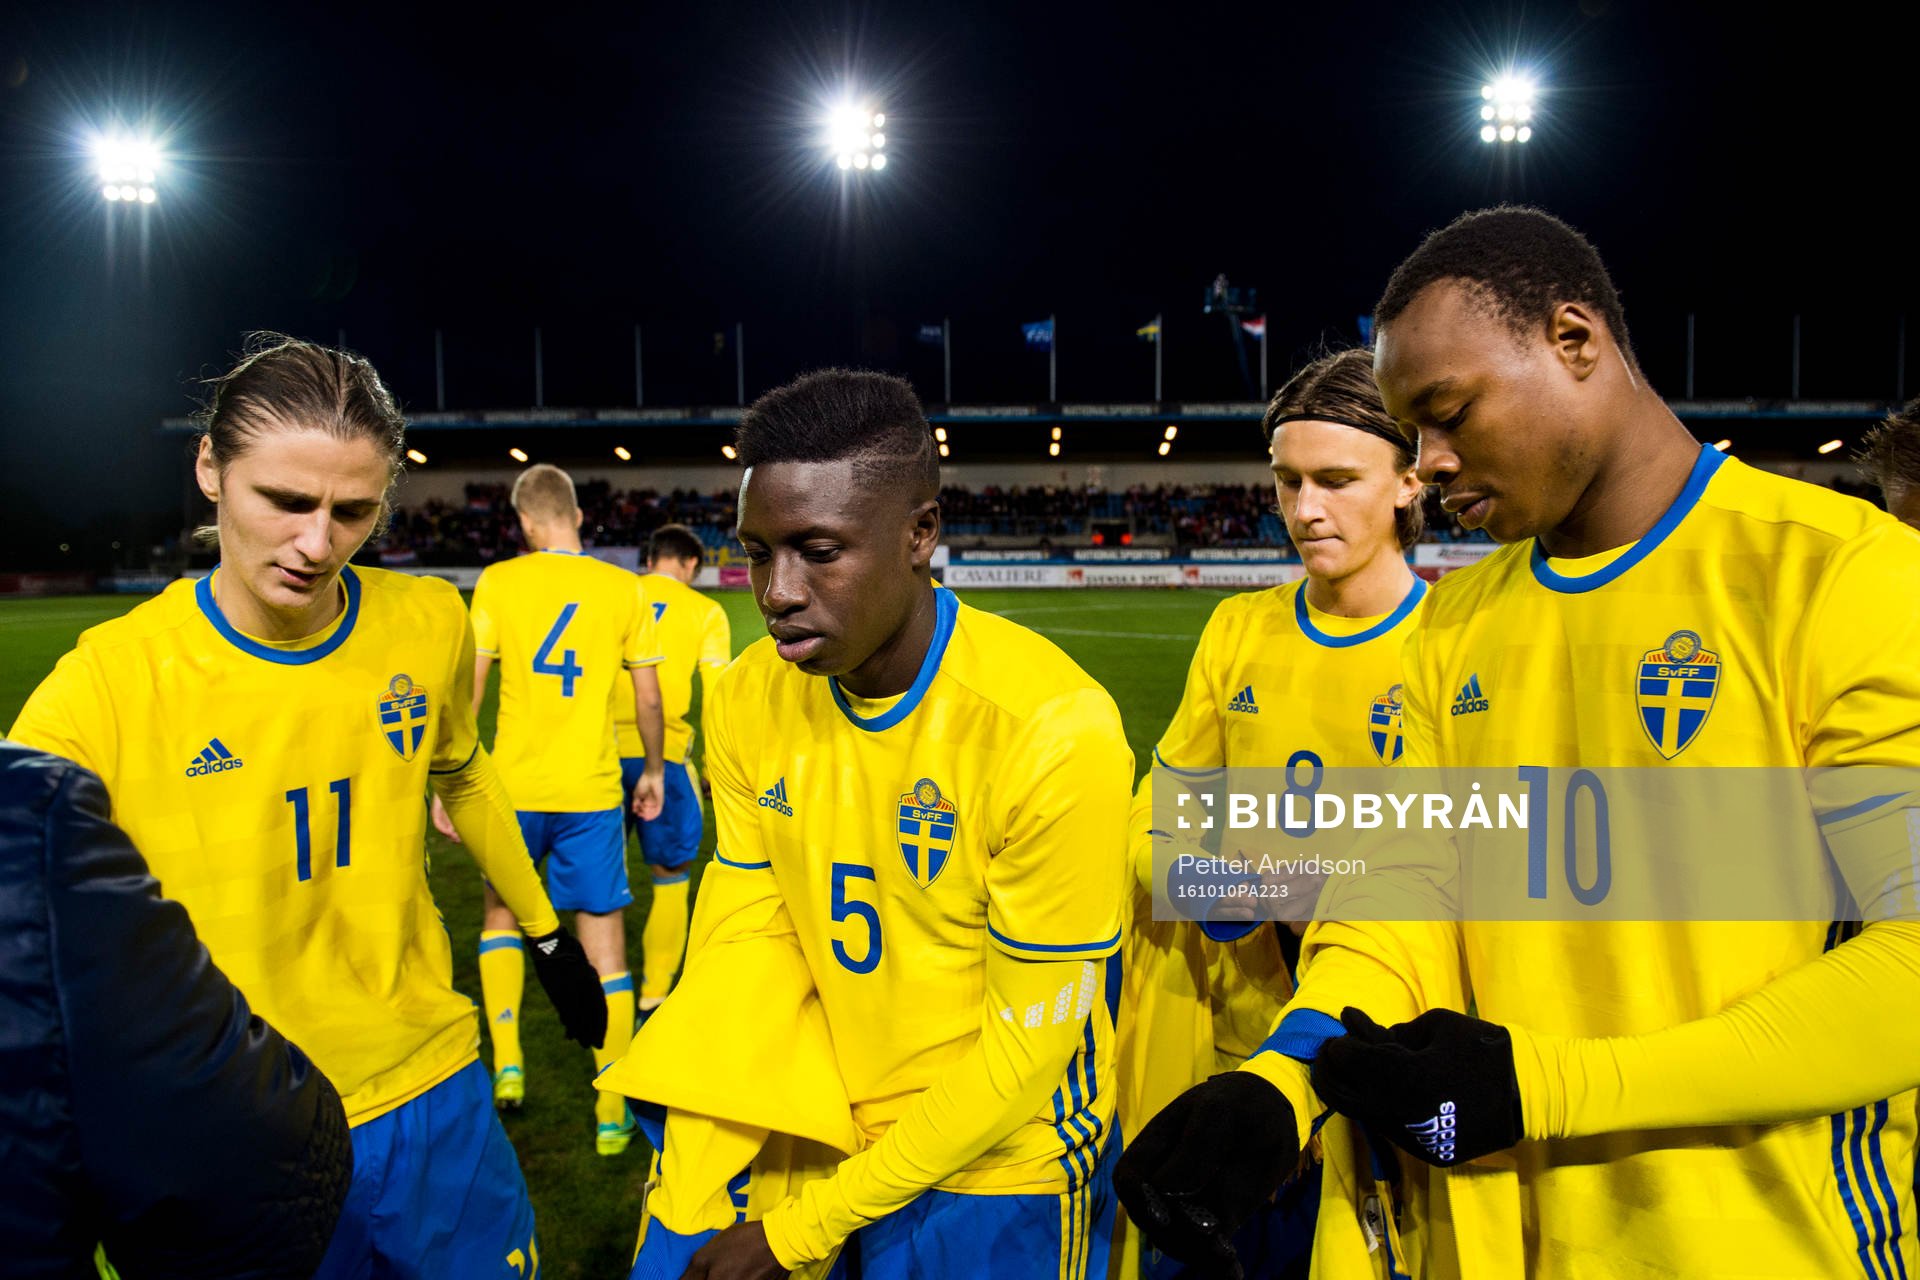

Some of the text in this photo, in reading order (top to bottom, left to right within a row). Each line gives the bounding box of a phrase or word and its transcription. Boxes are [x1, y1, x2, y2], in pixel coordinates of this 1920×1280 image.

[952, 568, 1043, 583] CAVALIERE
[532, 602, 583, 697] 4
[1657, 666, 1700, 677] SvFF
[1450, 697, 1489, 717] adidas
[185, 756, 244, 778] adidas
[758, 796, 794, 818] addas
[1277, 749, 1324, 839] 8
[285, 776, 351, 883] 11
[912, 809, 943, 822] SvFF
[1518, 764, 1612, 906] 10
[830, 861, 883, 975] 5
[1439, 1100, 1456, 1161] adidas
